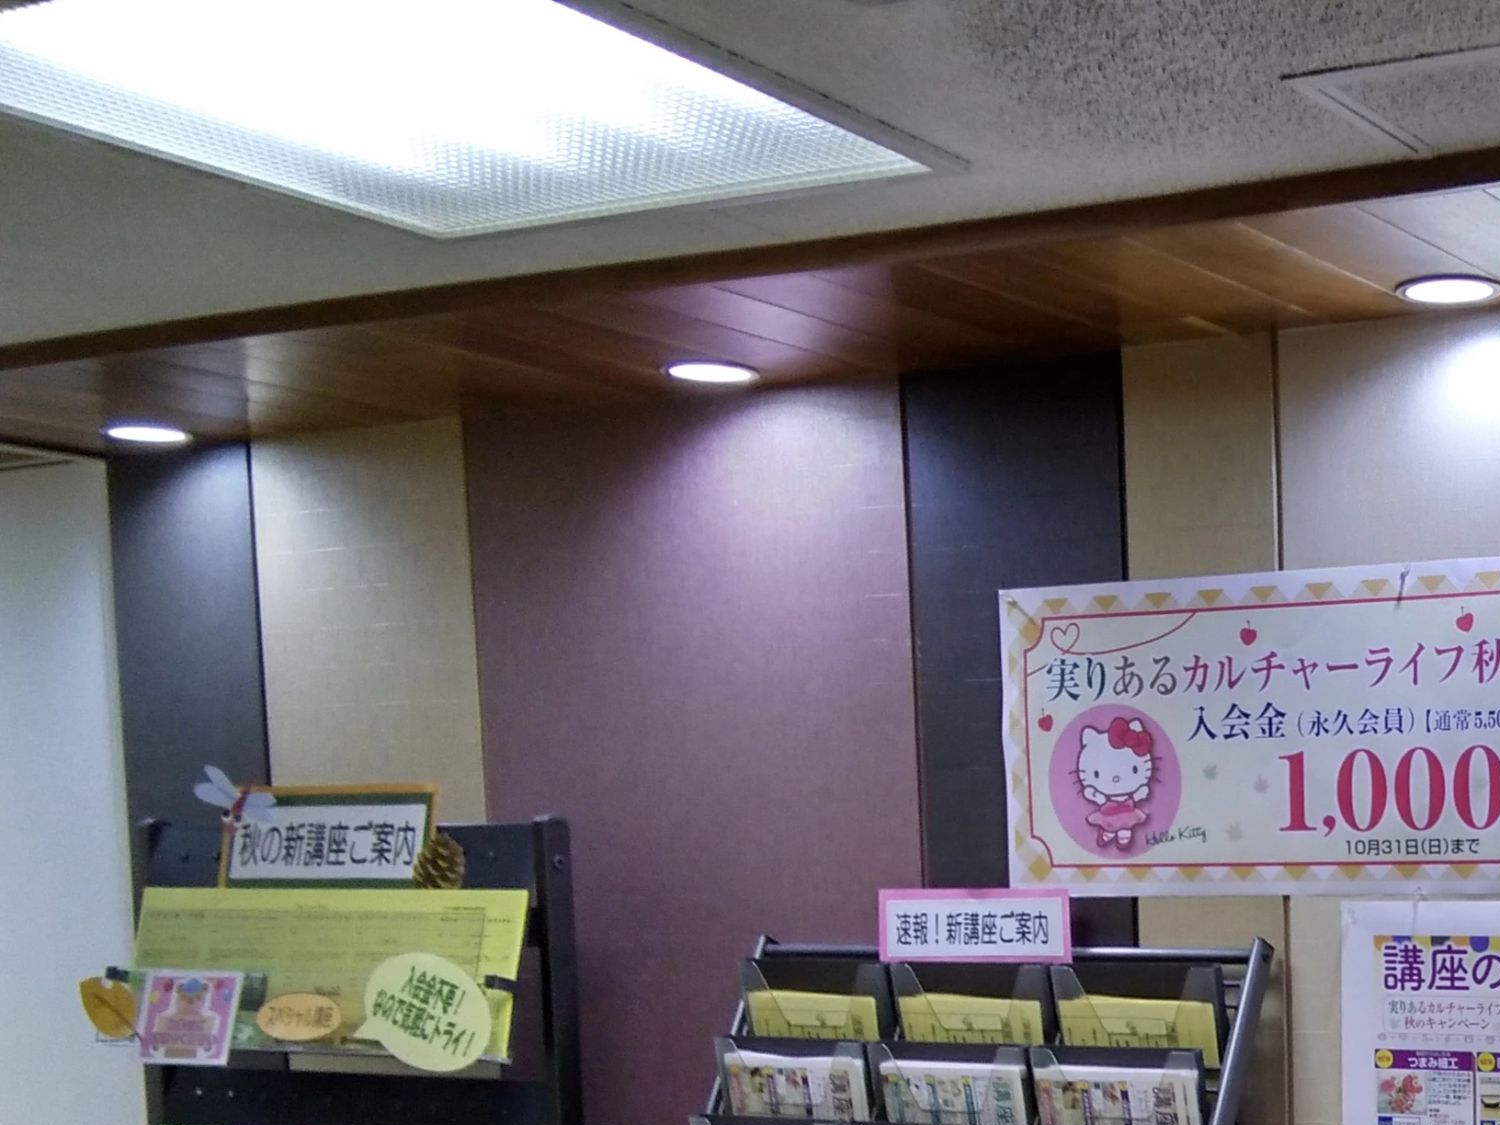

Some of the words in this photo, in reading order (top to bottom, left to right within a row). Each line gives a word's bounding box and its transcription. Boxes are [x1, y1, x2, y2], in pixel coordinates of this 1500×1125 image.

[238, 822, 415, 868] 秋の新講座ご案内
[1178, 825, 1207, 844] Kitty
[895, 910, 1050, 946] 速報！新講座ご案内
